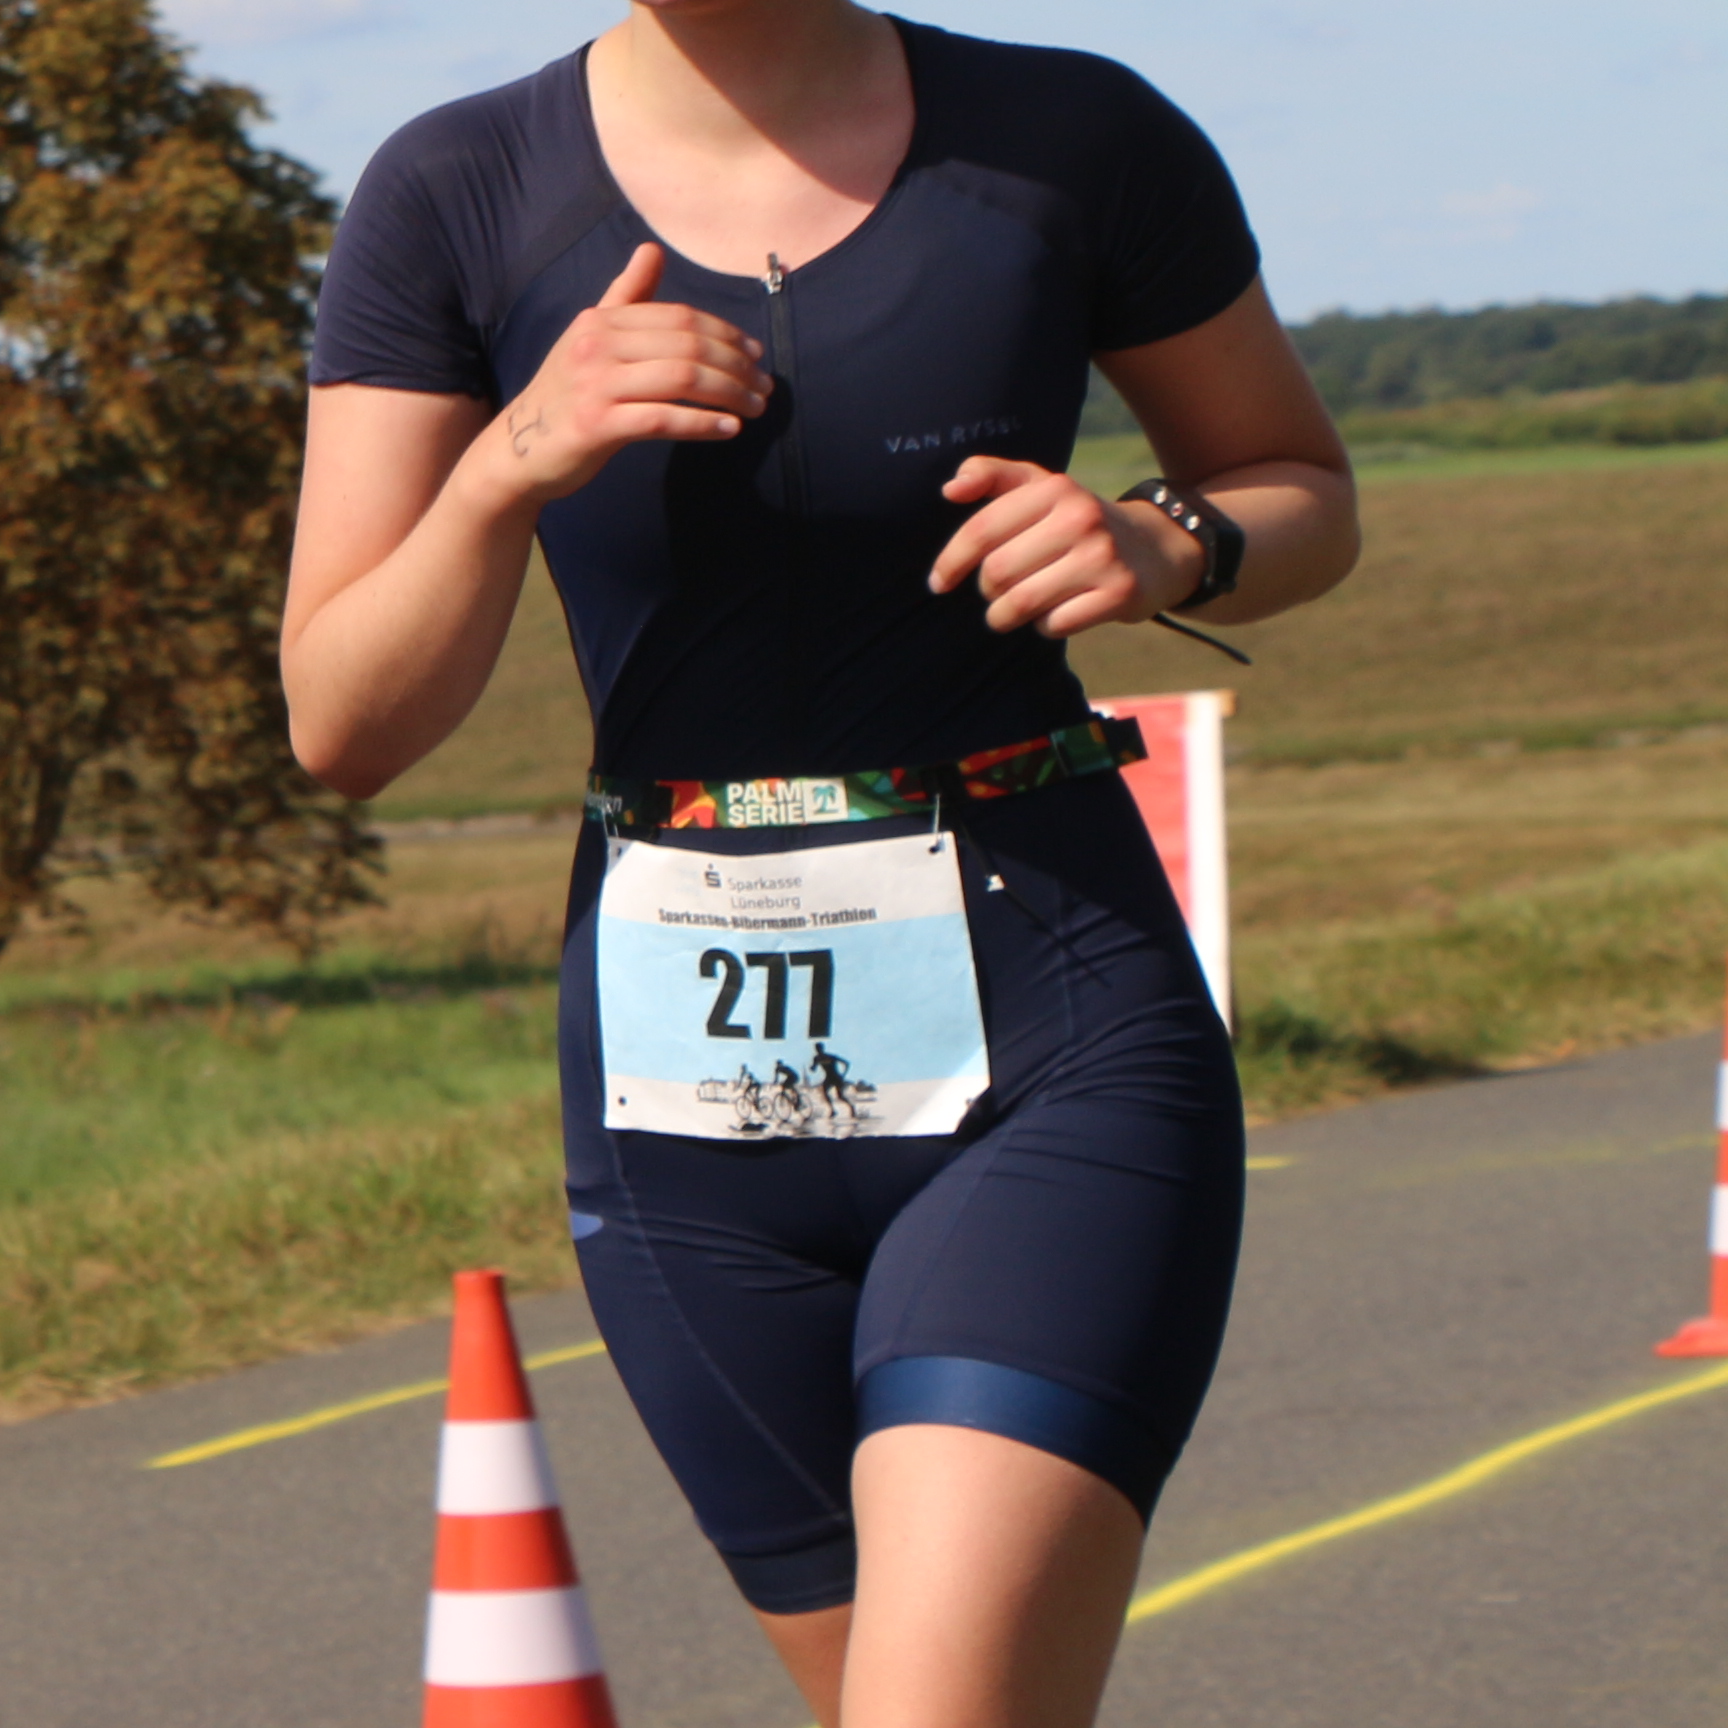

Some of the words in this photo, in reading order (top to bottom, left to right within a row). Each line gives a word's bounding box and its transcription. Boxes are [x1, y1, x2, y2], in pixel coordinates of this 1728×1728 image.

[885, 433, 940, 454] VAN
[726, 781, 802, 804] PALM
[727, 802, 803, 826] SERIE
[727, 875, 803, 893] Sparkasse
[730, 894, 802, 910] Lüneburg
[699, 946, 836, 1040] 277
